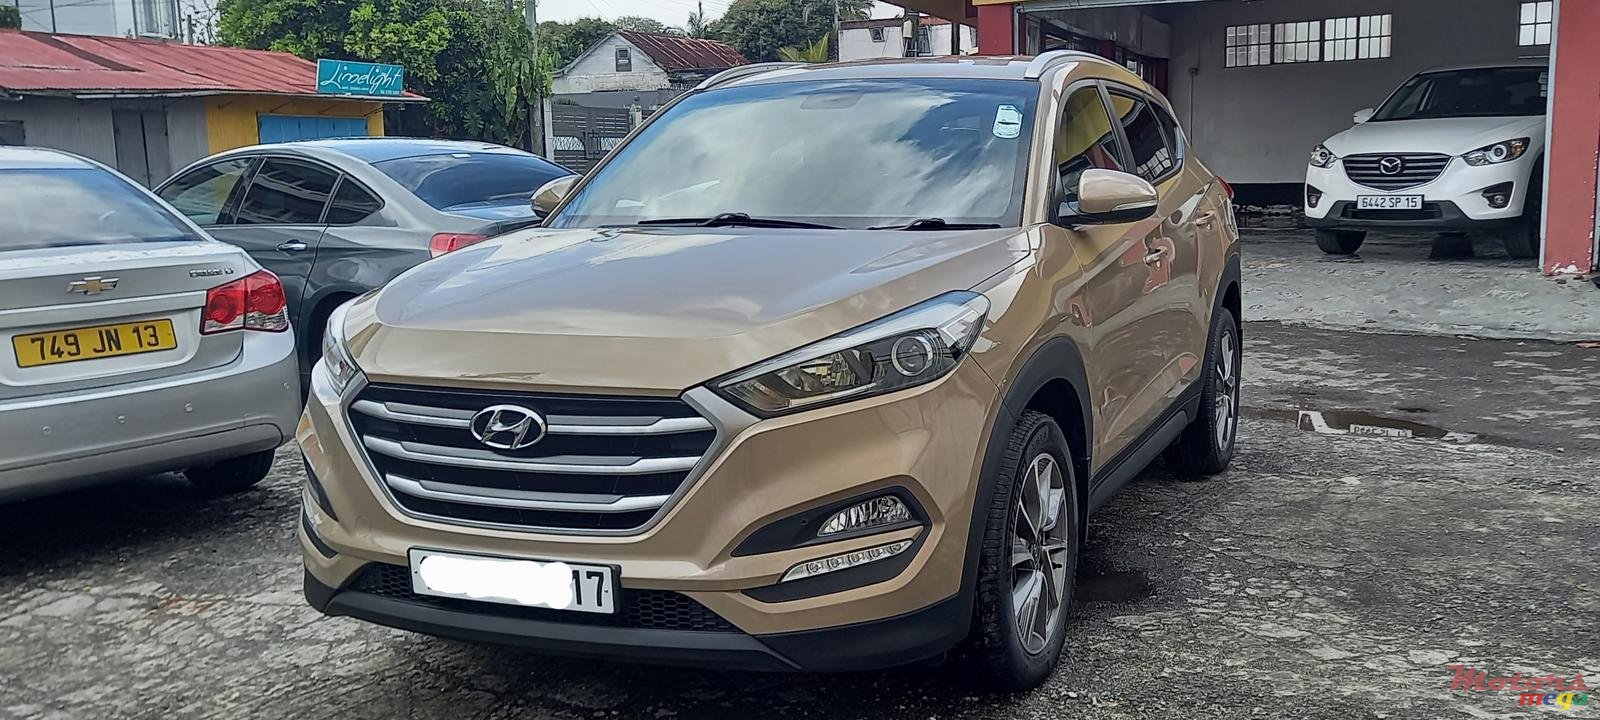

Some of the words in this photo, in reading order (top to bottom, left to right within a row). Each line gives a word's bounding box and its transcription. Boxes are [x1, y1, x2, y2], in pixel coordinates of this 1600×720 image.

[320, 63, 401, 94] Limelight
[1362, 197, 1386, 208] 6442
[1388, 197, 1401, 208] SP
[1405, 197, 1417, 208] 15
[30, 333, 81, 360] 749
[93, 327, 122, 353] JN
[131, 325, 160, 348] 13
[572, 569, 604, 607] 17
